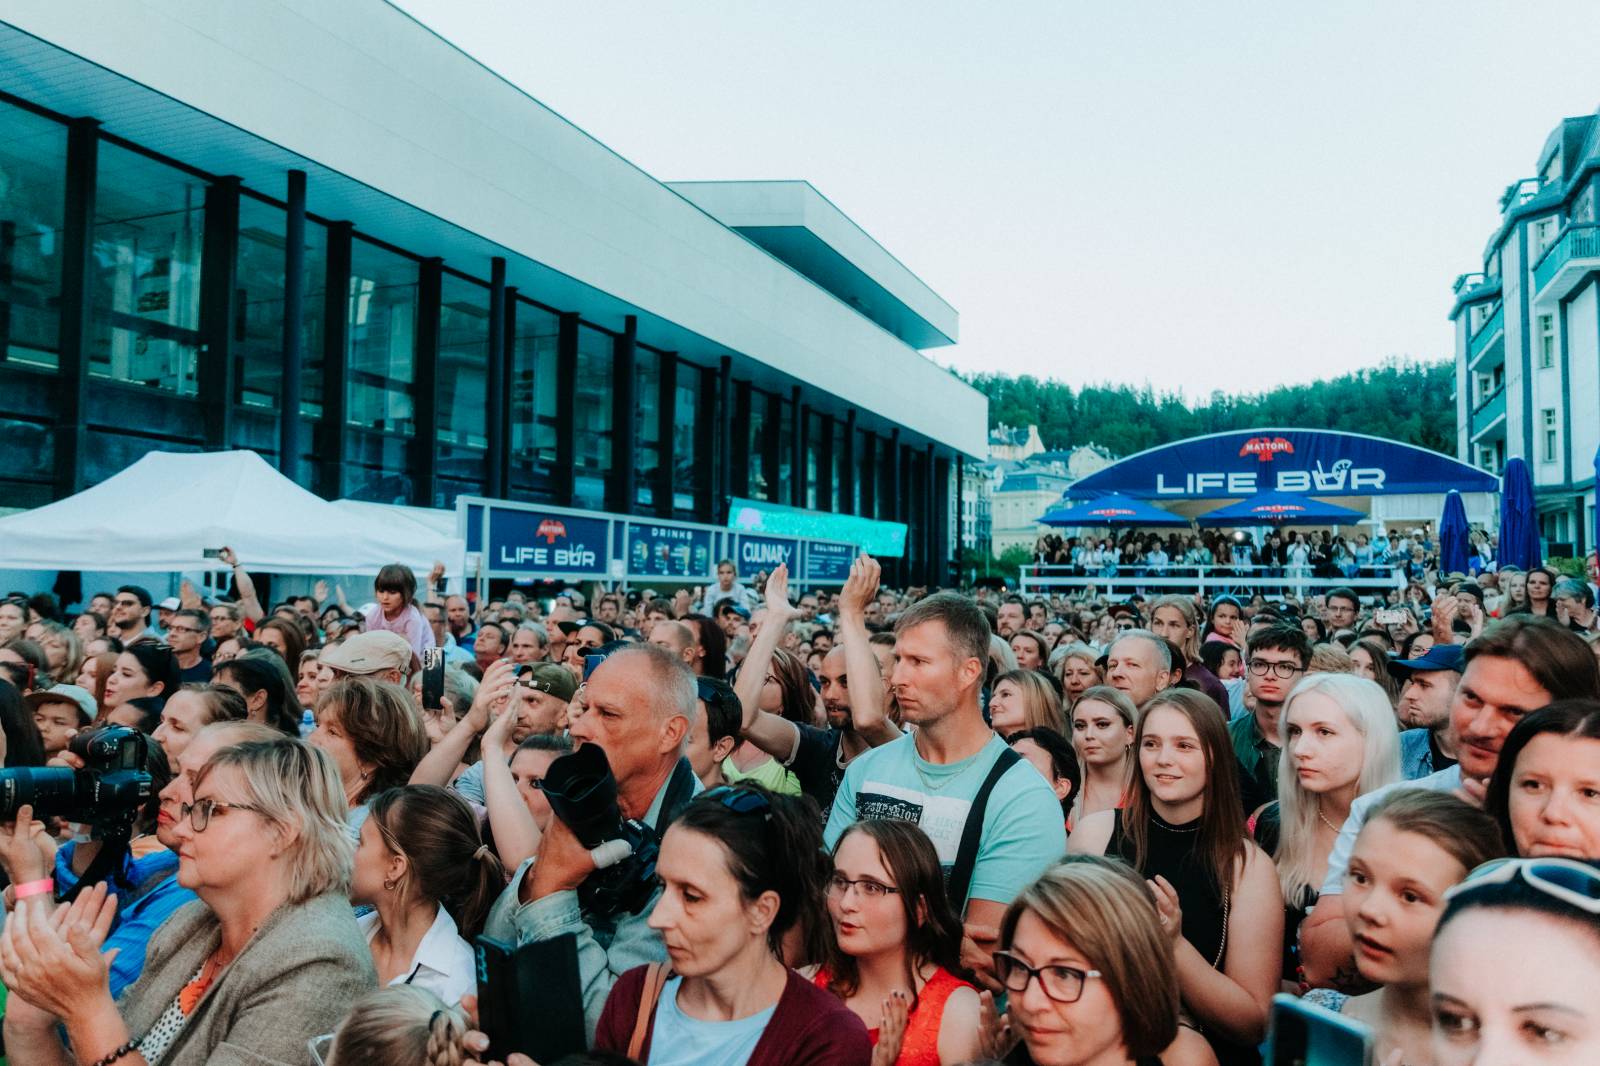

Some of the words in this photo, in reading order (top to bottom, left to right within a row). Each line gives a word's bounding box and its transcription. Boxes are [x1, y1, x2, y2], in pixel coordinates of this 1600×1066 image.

[1246, 441, 1288, 450] MATTONI
[1157, 472, 1257, 493] LIFE
[651, 527, 693, 540] DRINKS
[501, 545, 548, 565] LIFE
[743, 542, 792, 564] CULINARY
